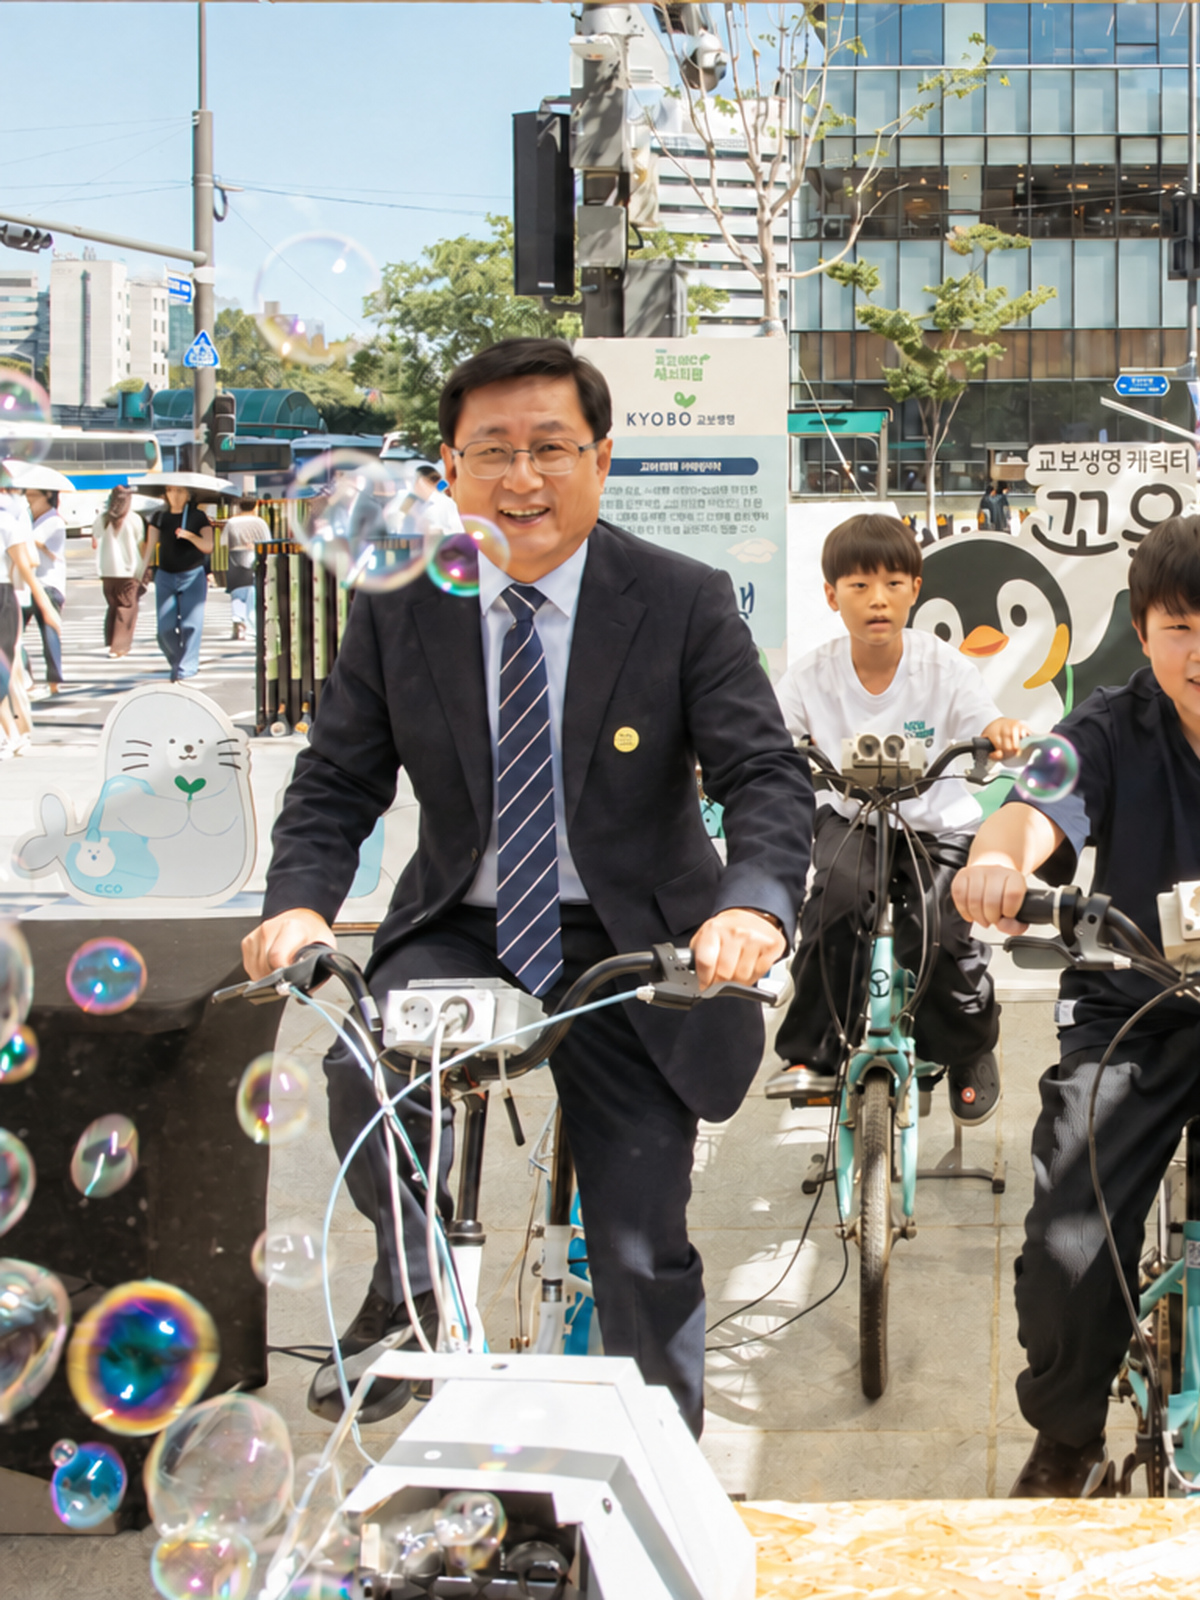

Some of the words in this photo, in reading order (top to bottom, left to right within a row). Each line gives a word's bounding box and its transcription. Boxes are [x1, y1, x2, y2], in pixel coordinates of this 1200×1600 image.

[626, 411, 692, 427] KYOBO
[1036, 449, 1121, 475] 교보생명
[1127, 449, 1190, 474] 캐릭터
